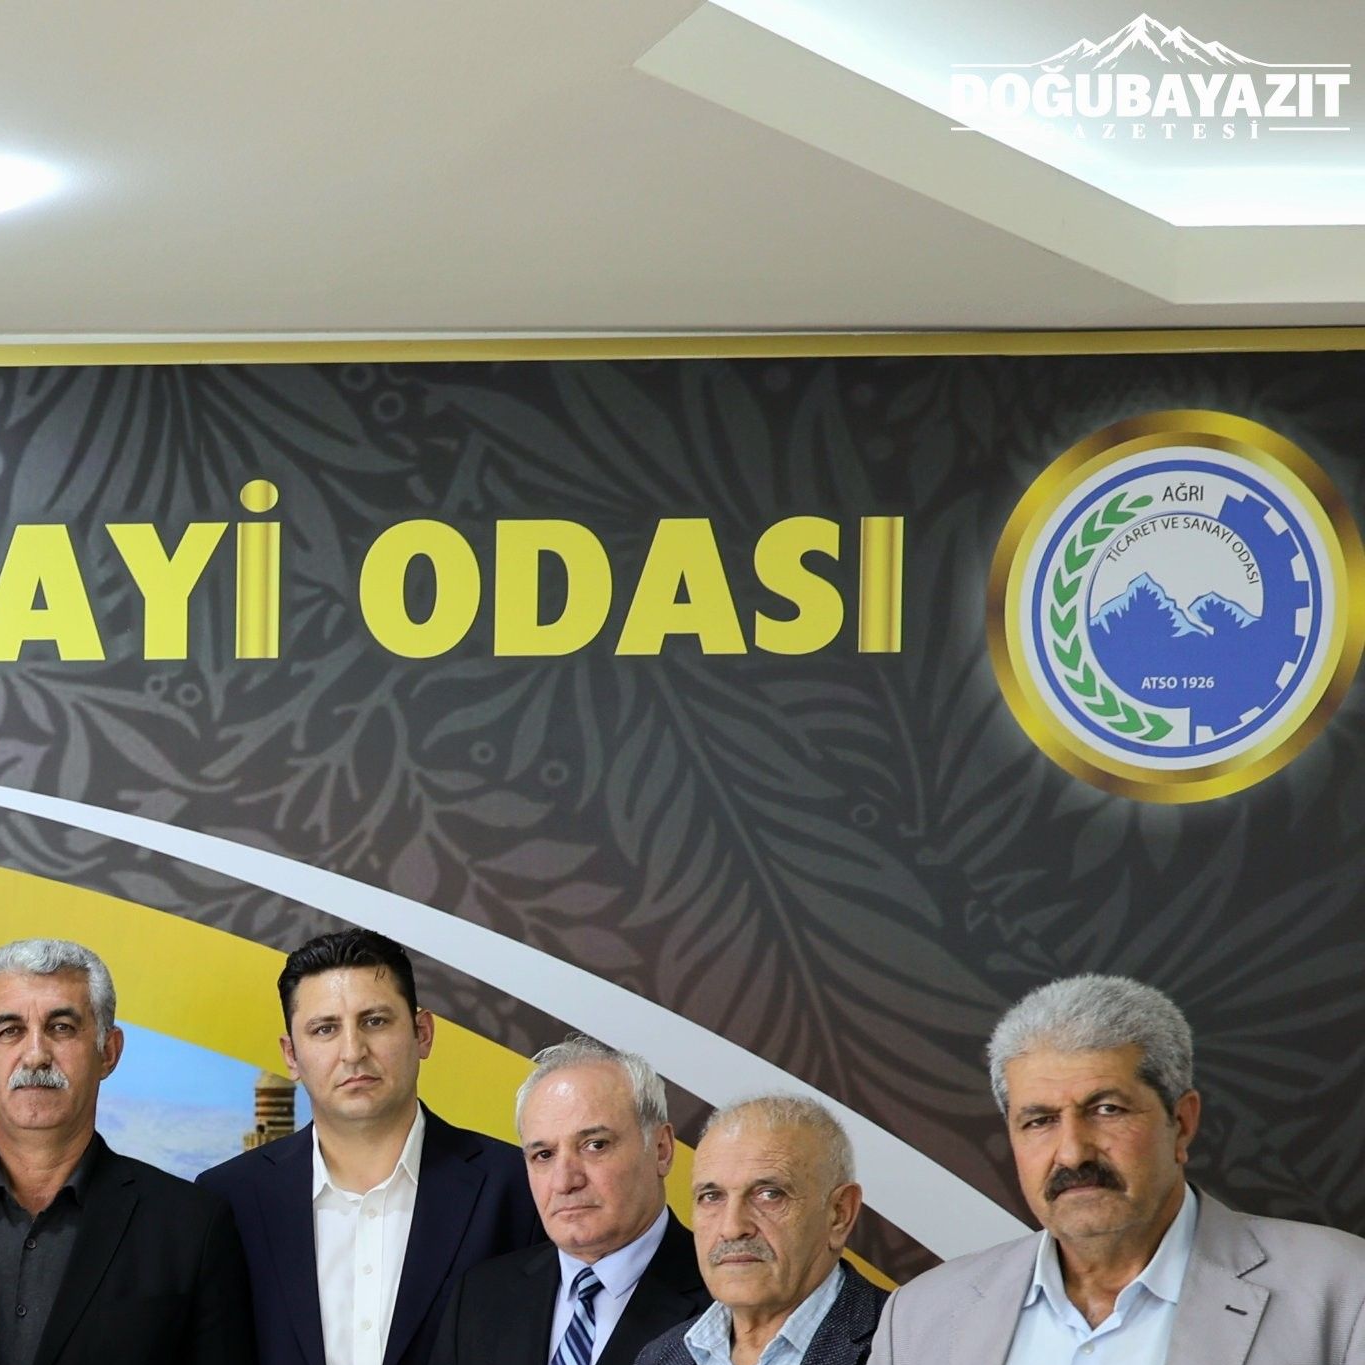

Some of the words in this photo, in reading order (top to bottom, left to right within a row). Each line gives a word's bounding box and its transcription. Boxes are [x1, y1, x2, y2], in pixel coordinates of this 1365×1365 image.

[1161, 482, 1204, 501] AĞRI
[1106, 520, 1158, 562] TİCARET
[1160, 517, 1180, 529] VE
[1183, 516, 1235, 544] SANAYİ
[1231, 541, 1260, 584] ODASI
[358, 514, 905, 659] ODASI
[1141, 676, 1178, 690] ATSO
[1181, 676, 1215, 690] 1926
